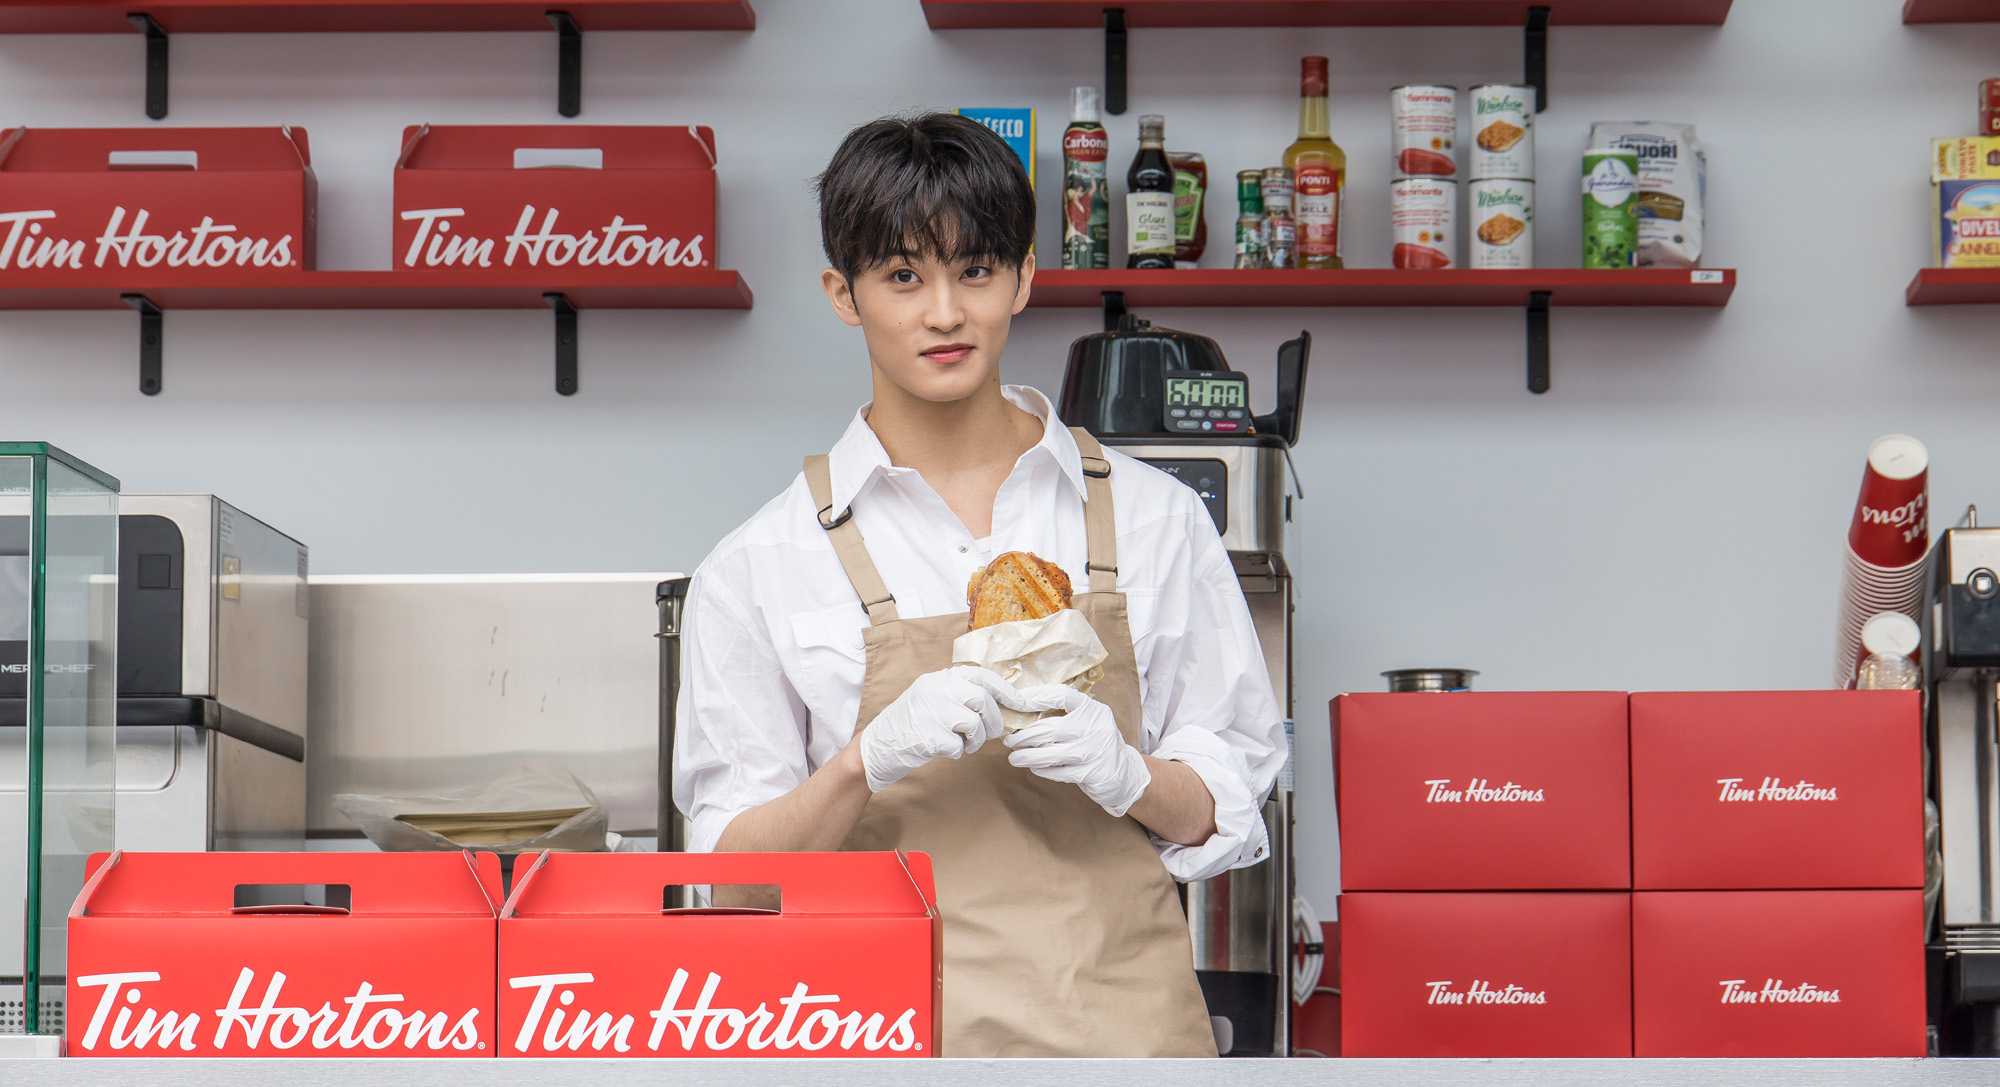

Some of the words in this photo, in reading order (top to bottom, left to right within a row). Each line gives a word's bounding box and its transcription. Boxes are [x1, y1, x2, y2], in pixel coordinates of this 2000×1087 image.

[1065, 134, 1107, 149] Carbon
[1300, 176, 1330, 185] PONTI
[1301, 205, 1329, 213] MELE
[0, 210, 85, 269] Tim
[95, 206, 292, 268] Hortons
[401, 208, 494, 267] Tim
[504, 205, 703, 267] Hortons
[1425, 780, 1462, 803] Tim
[1465, 778, 1544, 803] Hortons
[1717, 778, 1755, 802] Tim
[1758, 777, 1838, 802] Hortons
[1427, 981, 1464, 1005] Tim
[1467, 980, 1546, 1005] Hortons
[1720, 980, 1757, 1004] Tim
[1760, 979, 1840, 1004] Hortons
[77, 972, 200, 1052] Tim
[214, 967, 479, 1051] Hortons
[509, 973, 634, 1053] Tim
[648, 968, 917, 1052] Hortons
